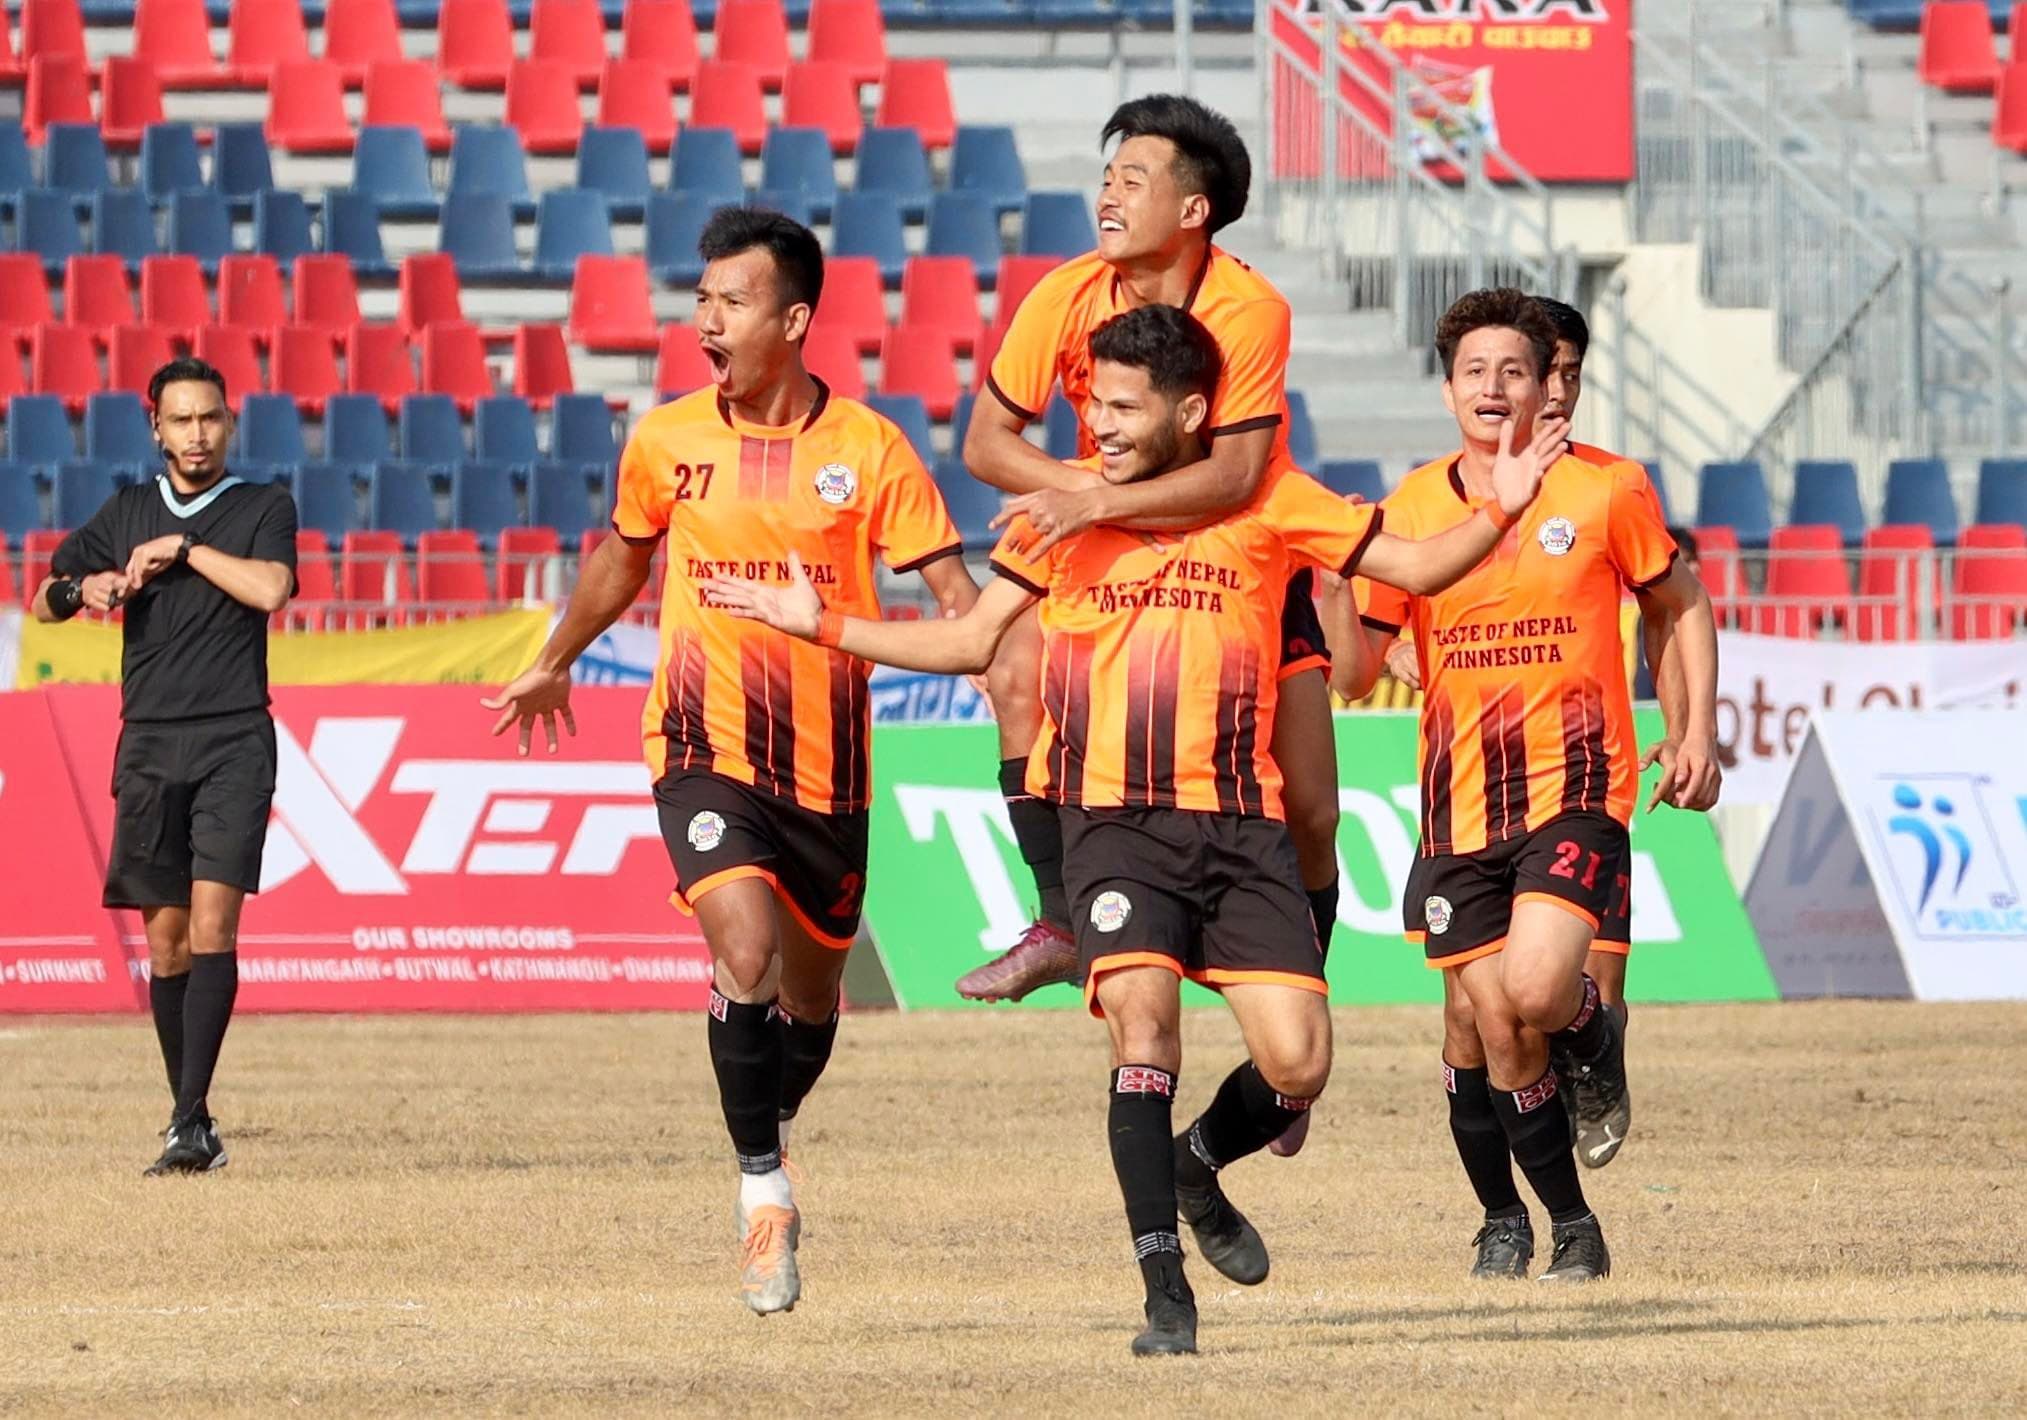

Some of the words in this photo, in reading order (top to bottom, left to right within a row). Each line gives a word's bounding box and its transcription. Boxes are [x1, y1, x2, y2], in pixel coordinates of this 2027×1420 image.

[674, 463, 715, 501] 27
[745, 561, 771, 581] OF
[777, 560, 836, 584] NPAL
[1176, 559, 1241, 590] NEPAL
[1432, 624, 1481, 646] TASTE
[1486, 622, 1509, 640] OF
[1513, 616, 1577, 639] NEPAL
[1442, 643, 1563, 669] MINNESOTA
[1549, 840, 1602, 891] 21
[352, 926, 408, 951] OUR
[412, 926, 575, 951] SHOWROOMS
